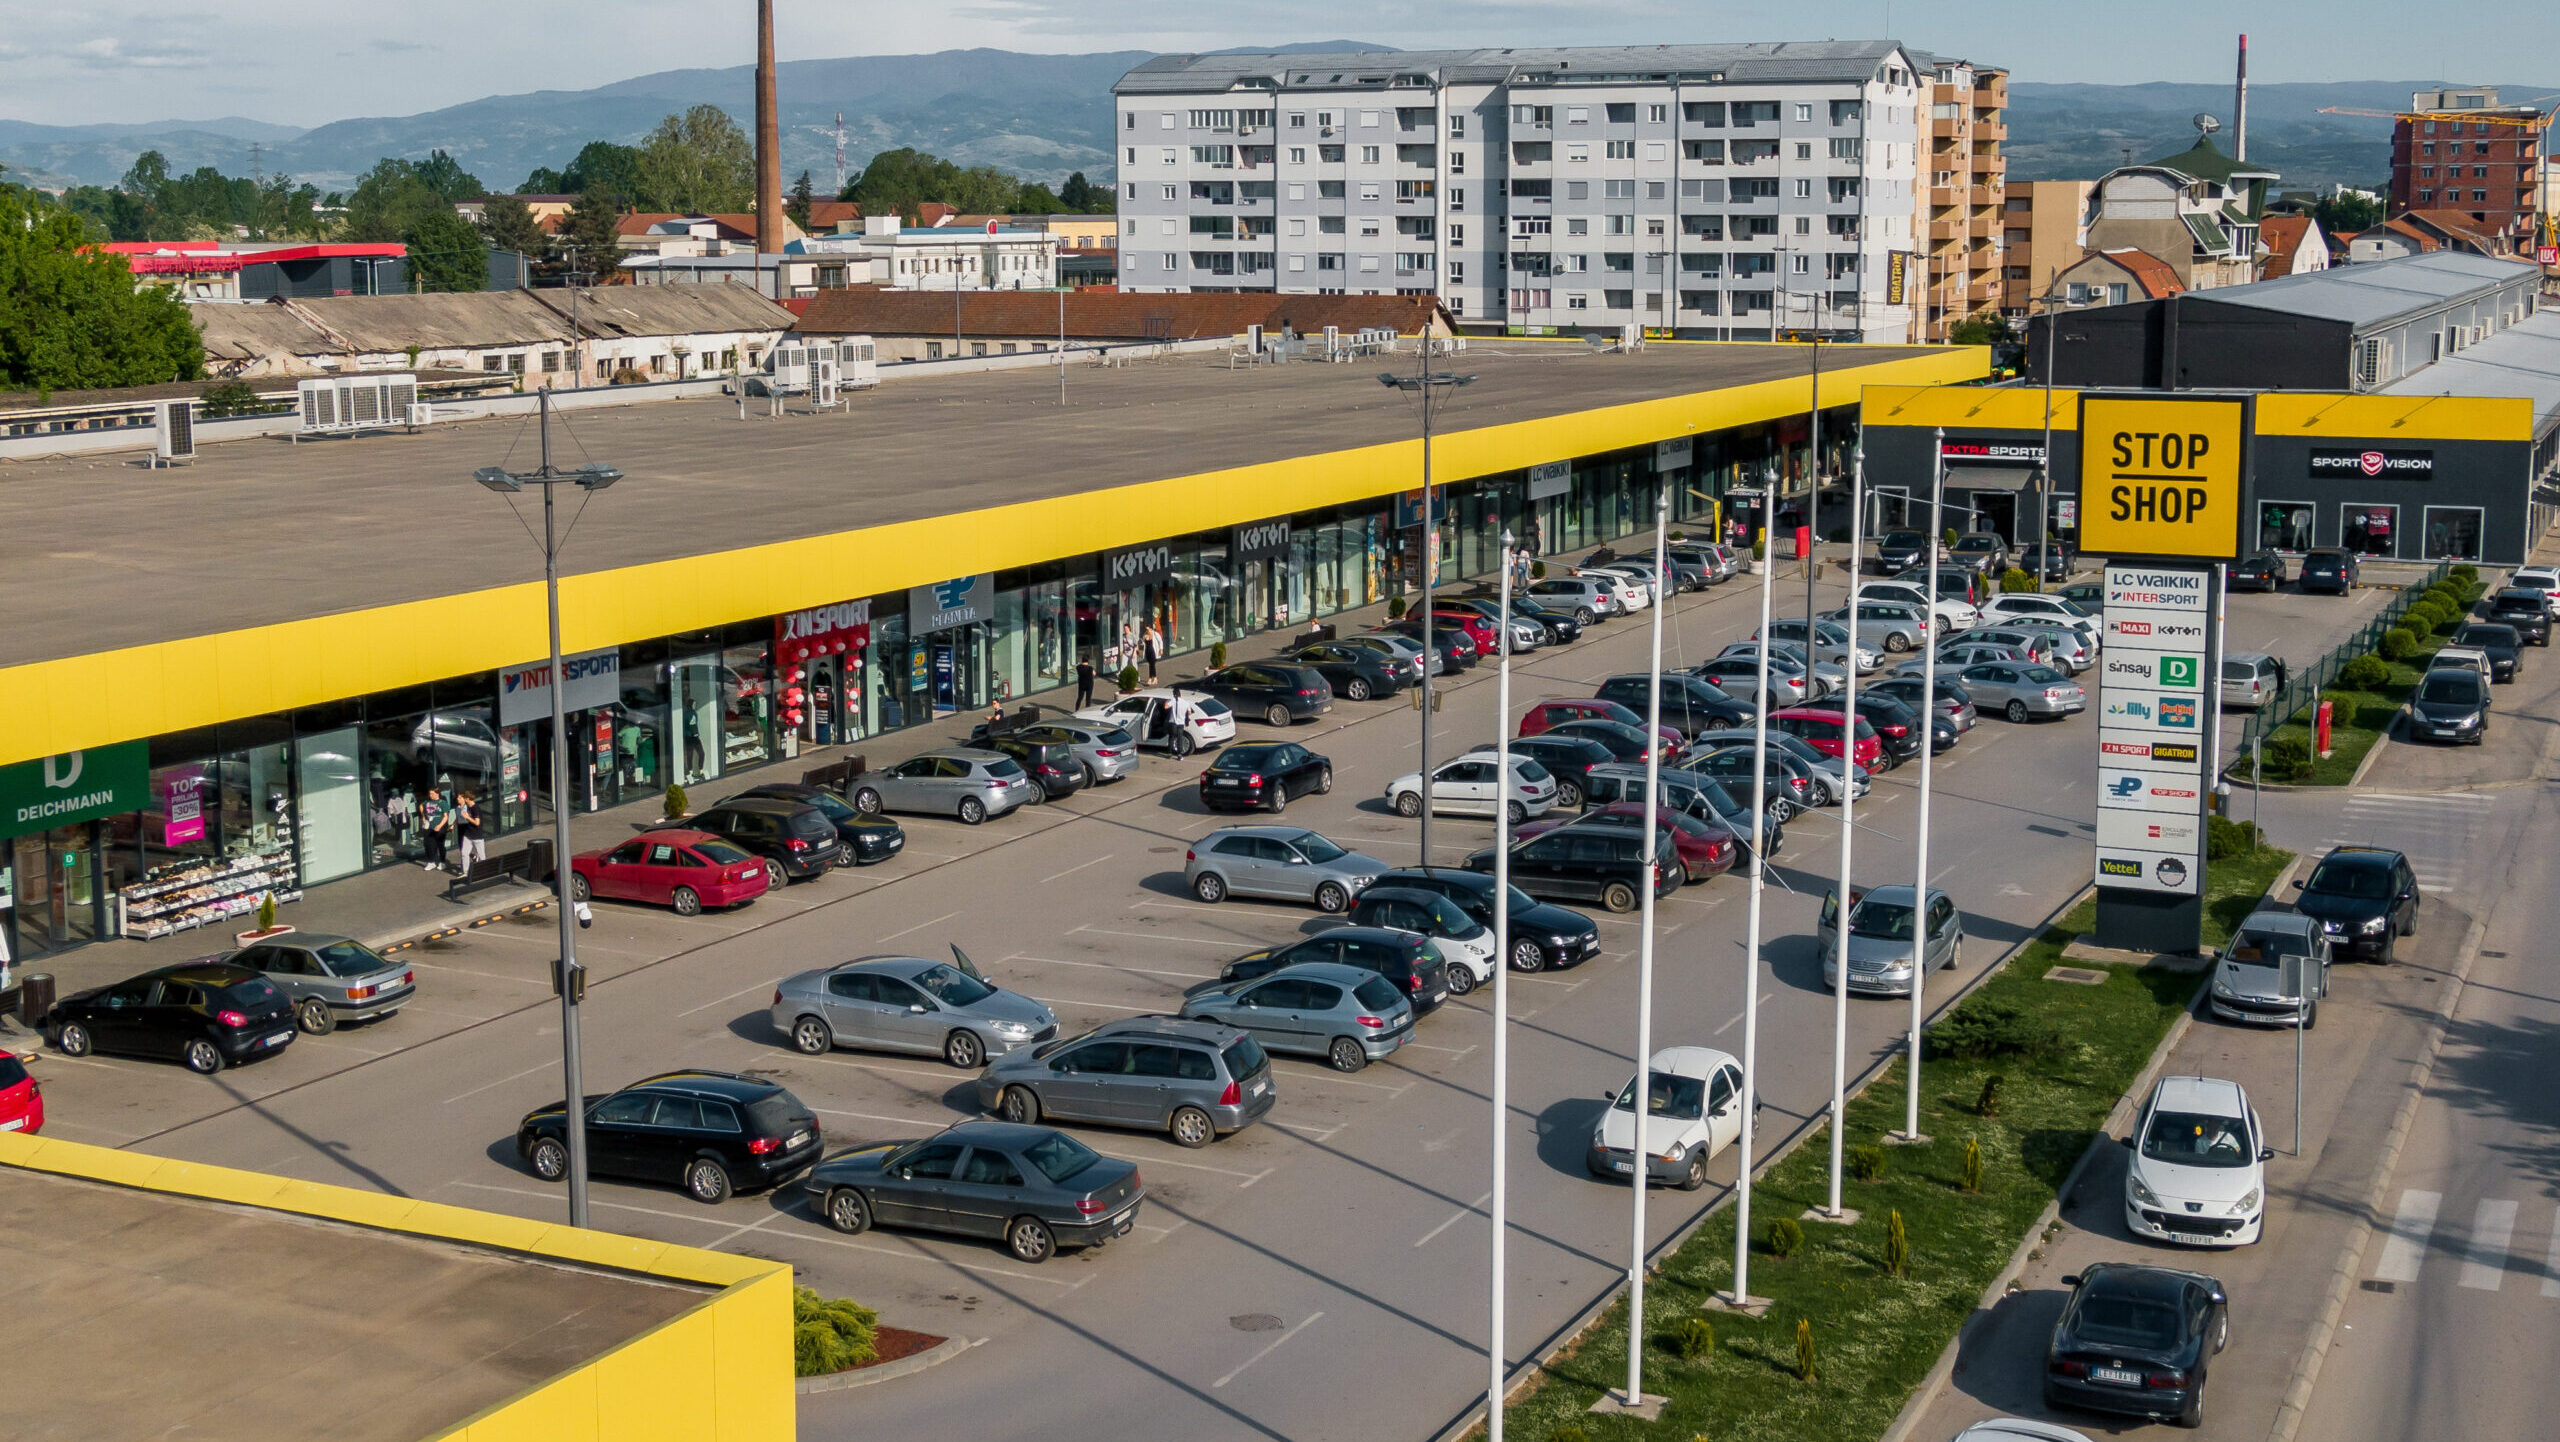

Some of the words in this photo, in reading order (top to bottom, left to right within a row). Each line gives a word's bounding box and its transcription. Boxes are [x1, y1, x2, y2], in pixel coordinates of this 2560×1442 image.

[1890, 253, 1902, 303] GIGATRON
[1941, 445, 2045, 457] EXTRASPORTS
[2112, 431, 2210, 470] STOP
[2312, 457, 2361, 468] SPORT
[2384, 458, 2432, 470] VISION
[2110, 485, 2208, 524] SHOP
[2113, 573, 2134, 586] LC
[2122, 592, 2199, 605] INTERSPORT
[813, 598, 873, 635] SPORT
[2122, 623, 2149, 634] MAXI
[520, 653, 620, 691] INTRSPORT
[2108, 660, 2152, 678] sinsay
[2170, 661, 2188, 678] D
[2127, 702, 2151, 719] lilly
[2120, 746, 2148, 755] SPORT
[2153, 747, 2195, 758] GIGATRON
[44, 751, 84, 788] D
[171, 777, 200, 795] TOP
[17, 790, 113, 822] DEICHMANN
[2102, 861, 2140, 875] Yettel.
